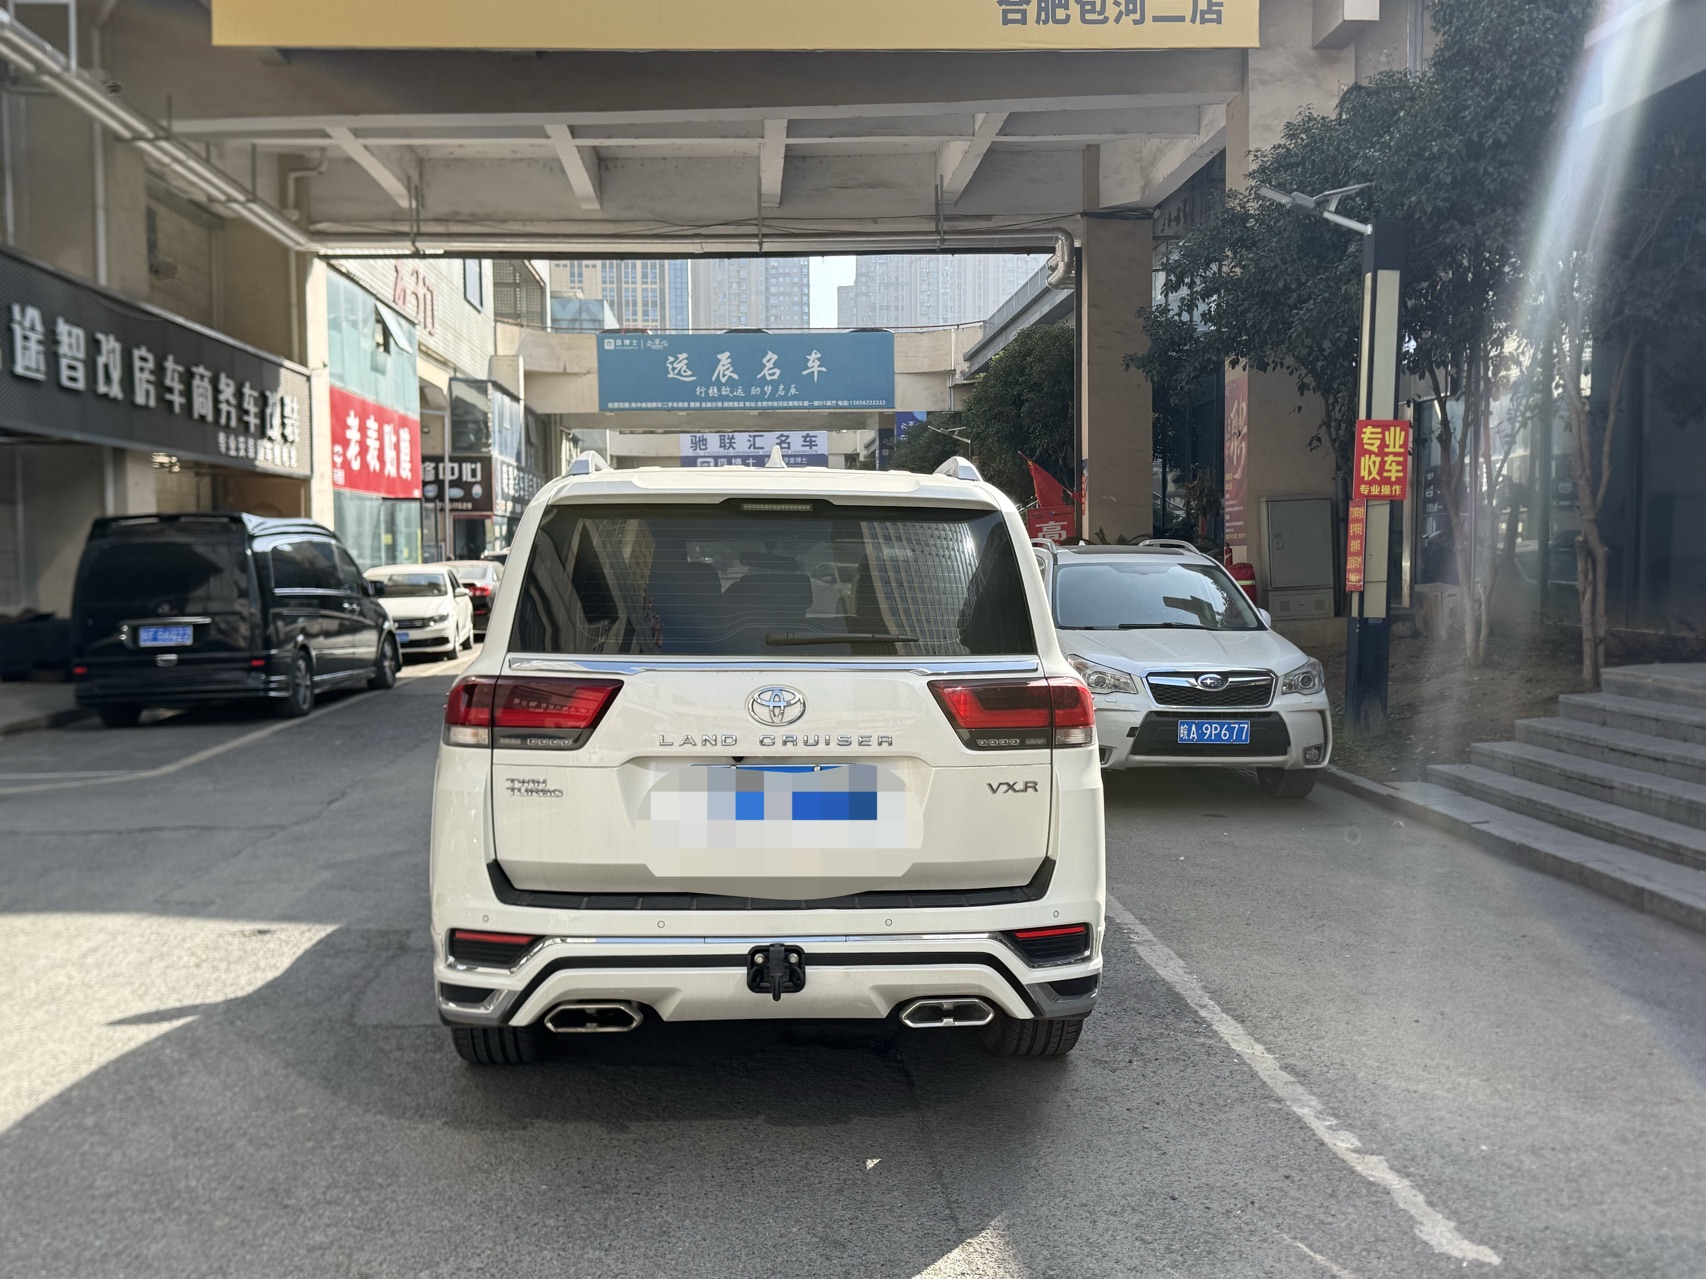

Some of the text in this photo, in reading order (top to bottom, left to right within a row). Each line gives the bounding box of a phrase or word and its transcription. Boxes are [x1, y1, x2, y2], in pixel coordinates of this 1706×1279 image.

[666, 350, 827, 383] 远辰名车
[689, 433, 819, 451] 驰联汇名车
[1361, 425, 1406, 453] 专业
[1360, 454, 1404, 482] 收车
[1359, 484, 1402, 496] 专业操作
[658, 734, 894, 747] LAND CRUISER
